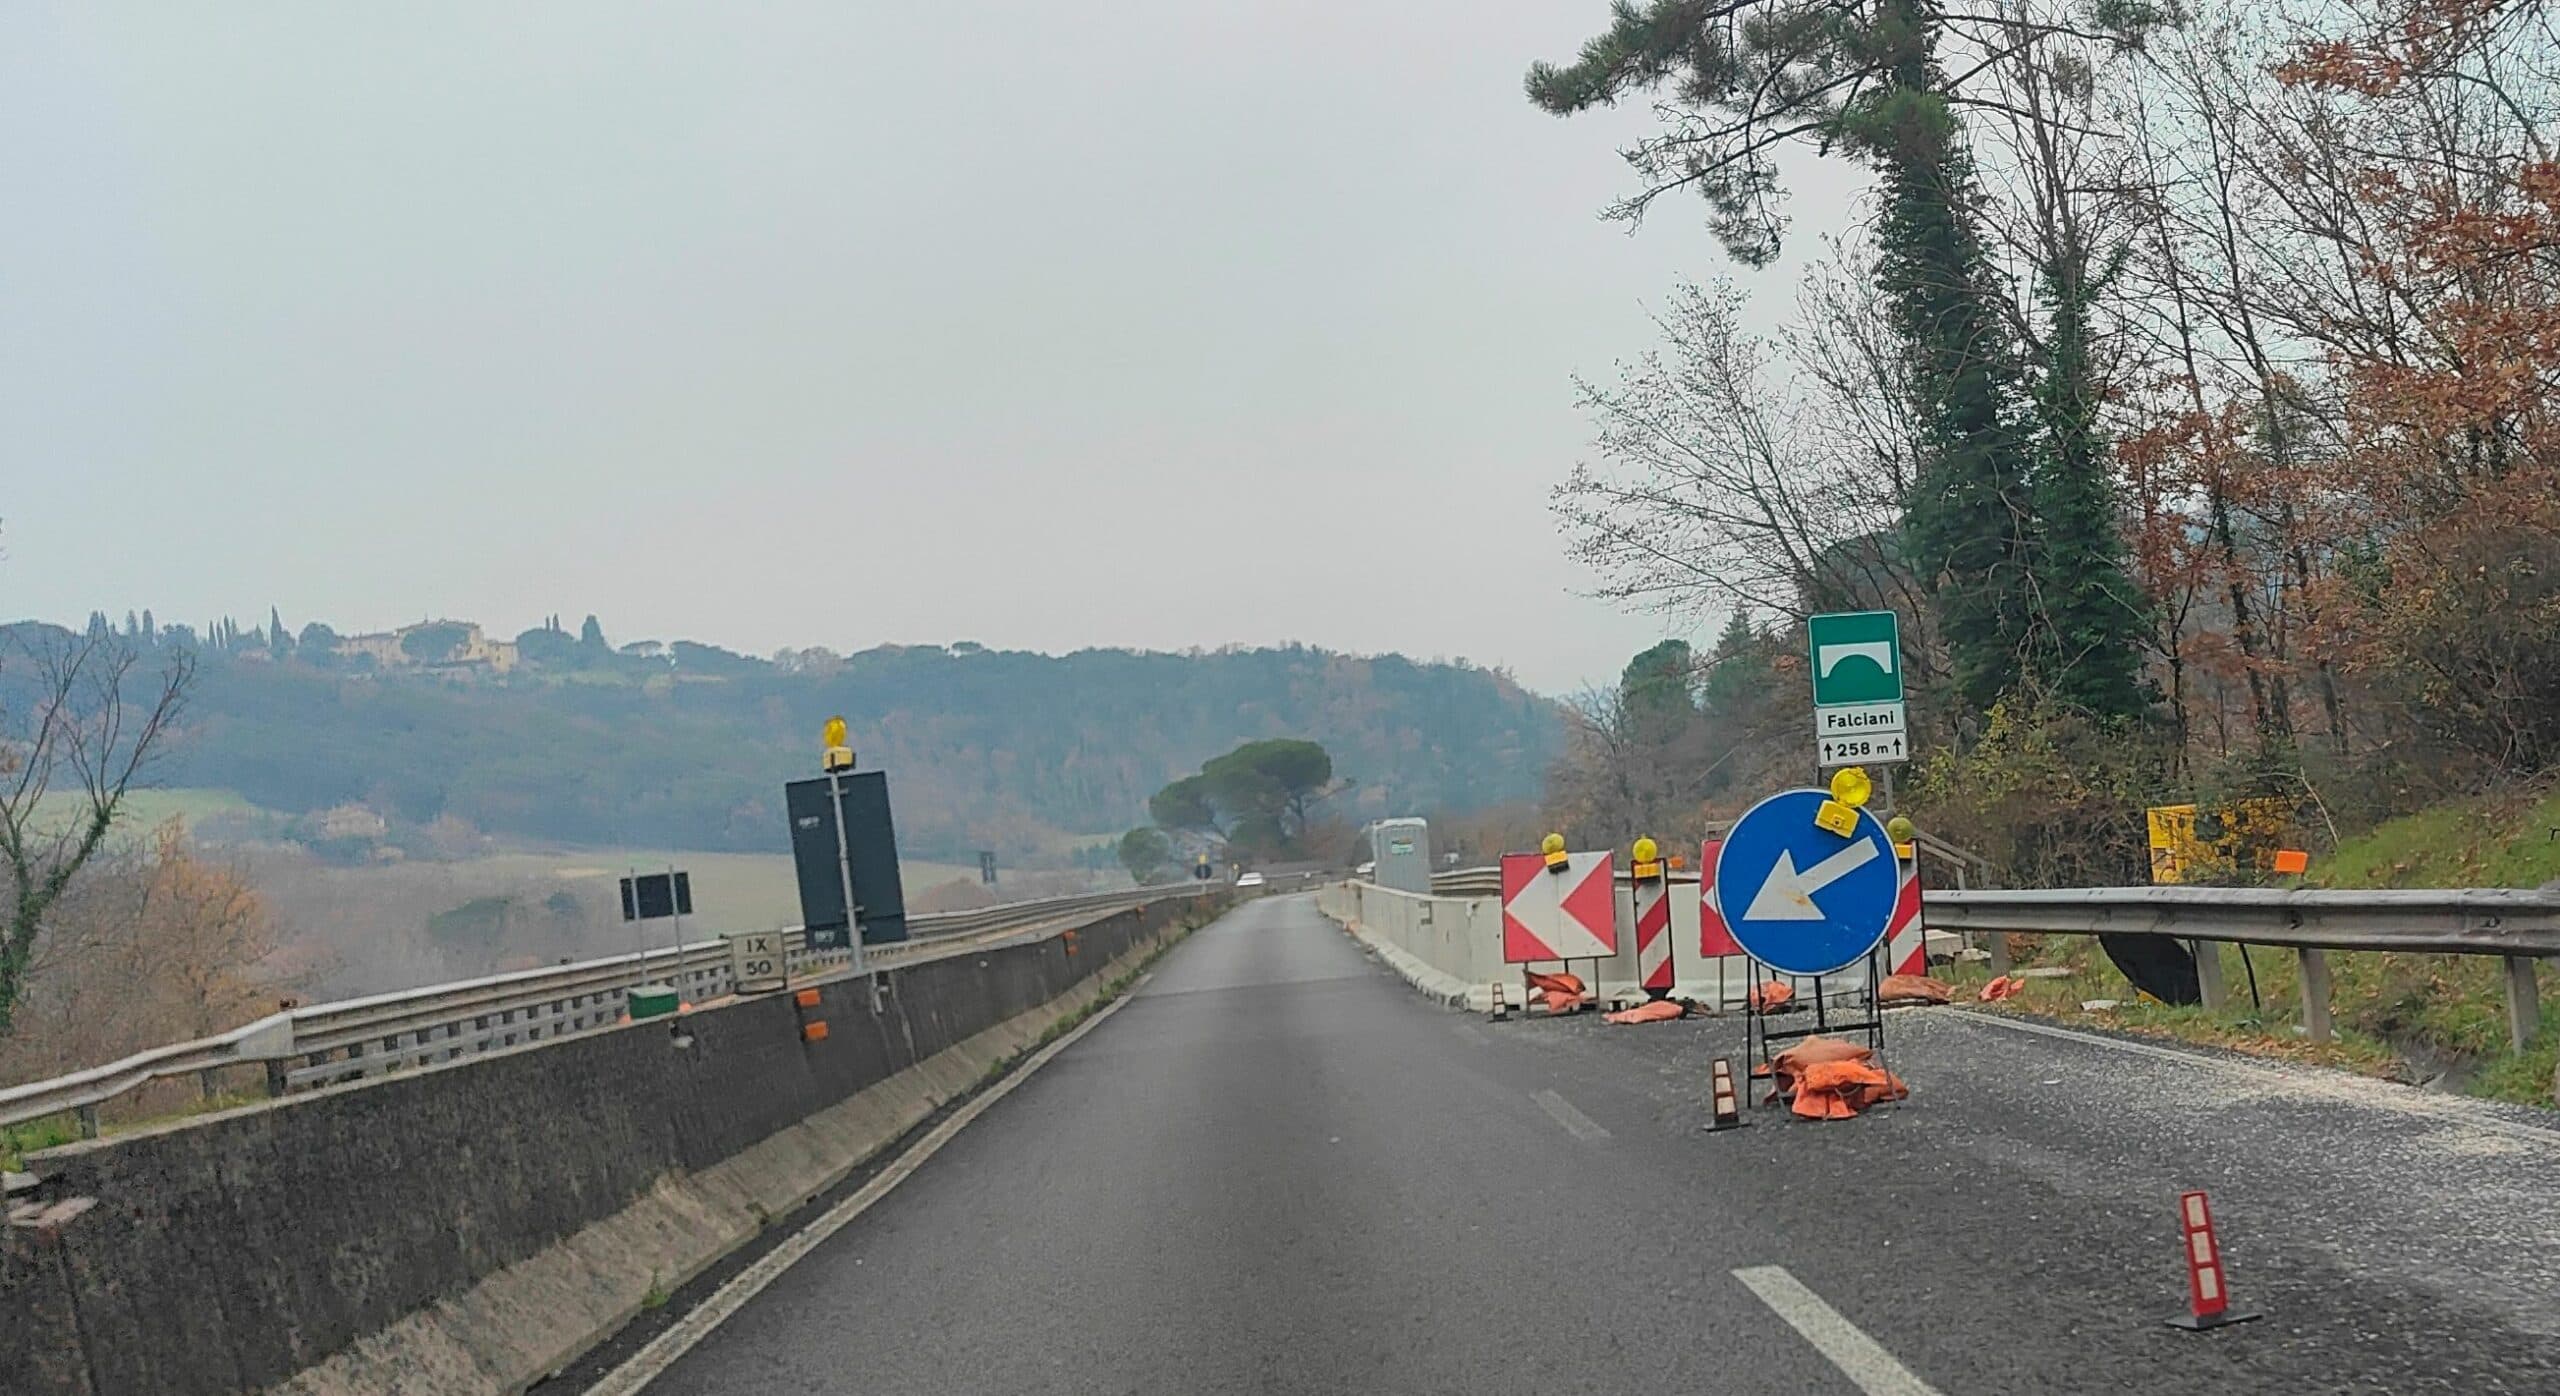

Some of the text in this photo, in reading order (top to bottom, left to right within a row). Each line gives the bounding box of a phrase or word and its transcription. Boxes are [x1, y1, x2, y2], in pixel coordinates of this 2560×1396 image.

[1827, 710, 1894, 728] Falciani
[1837, 742, 1889, 757] 258 m
[746, 960, 772, 975] 50
